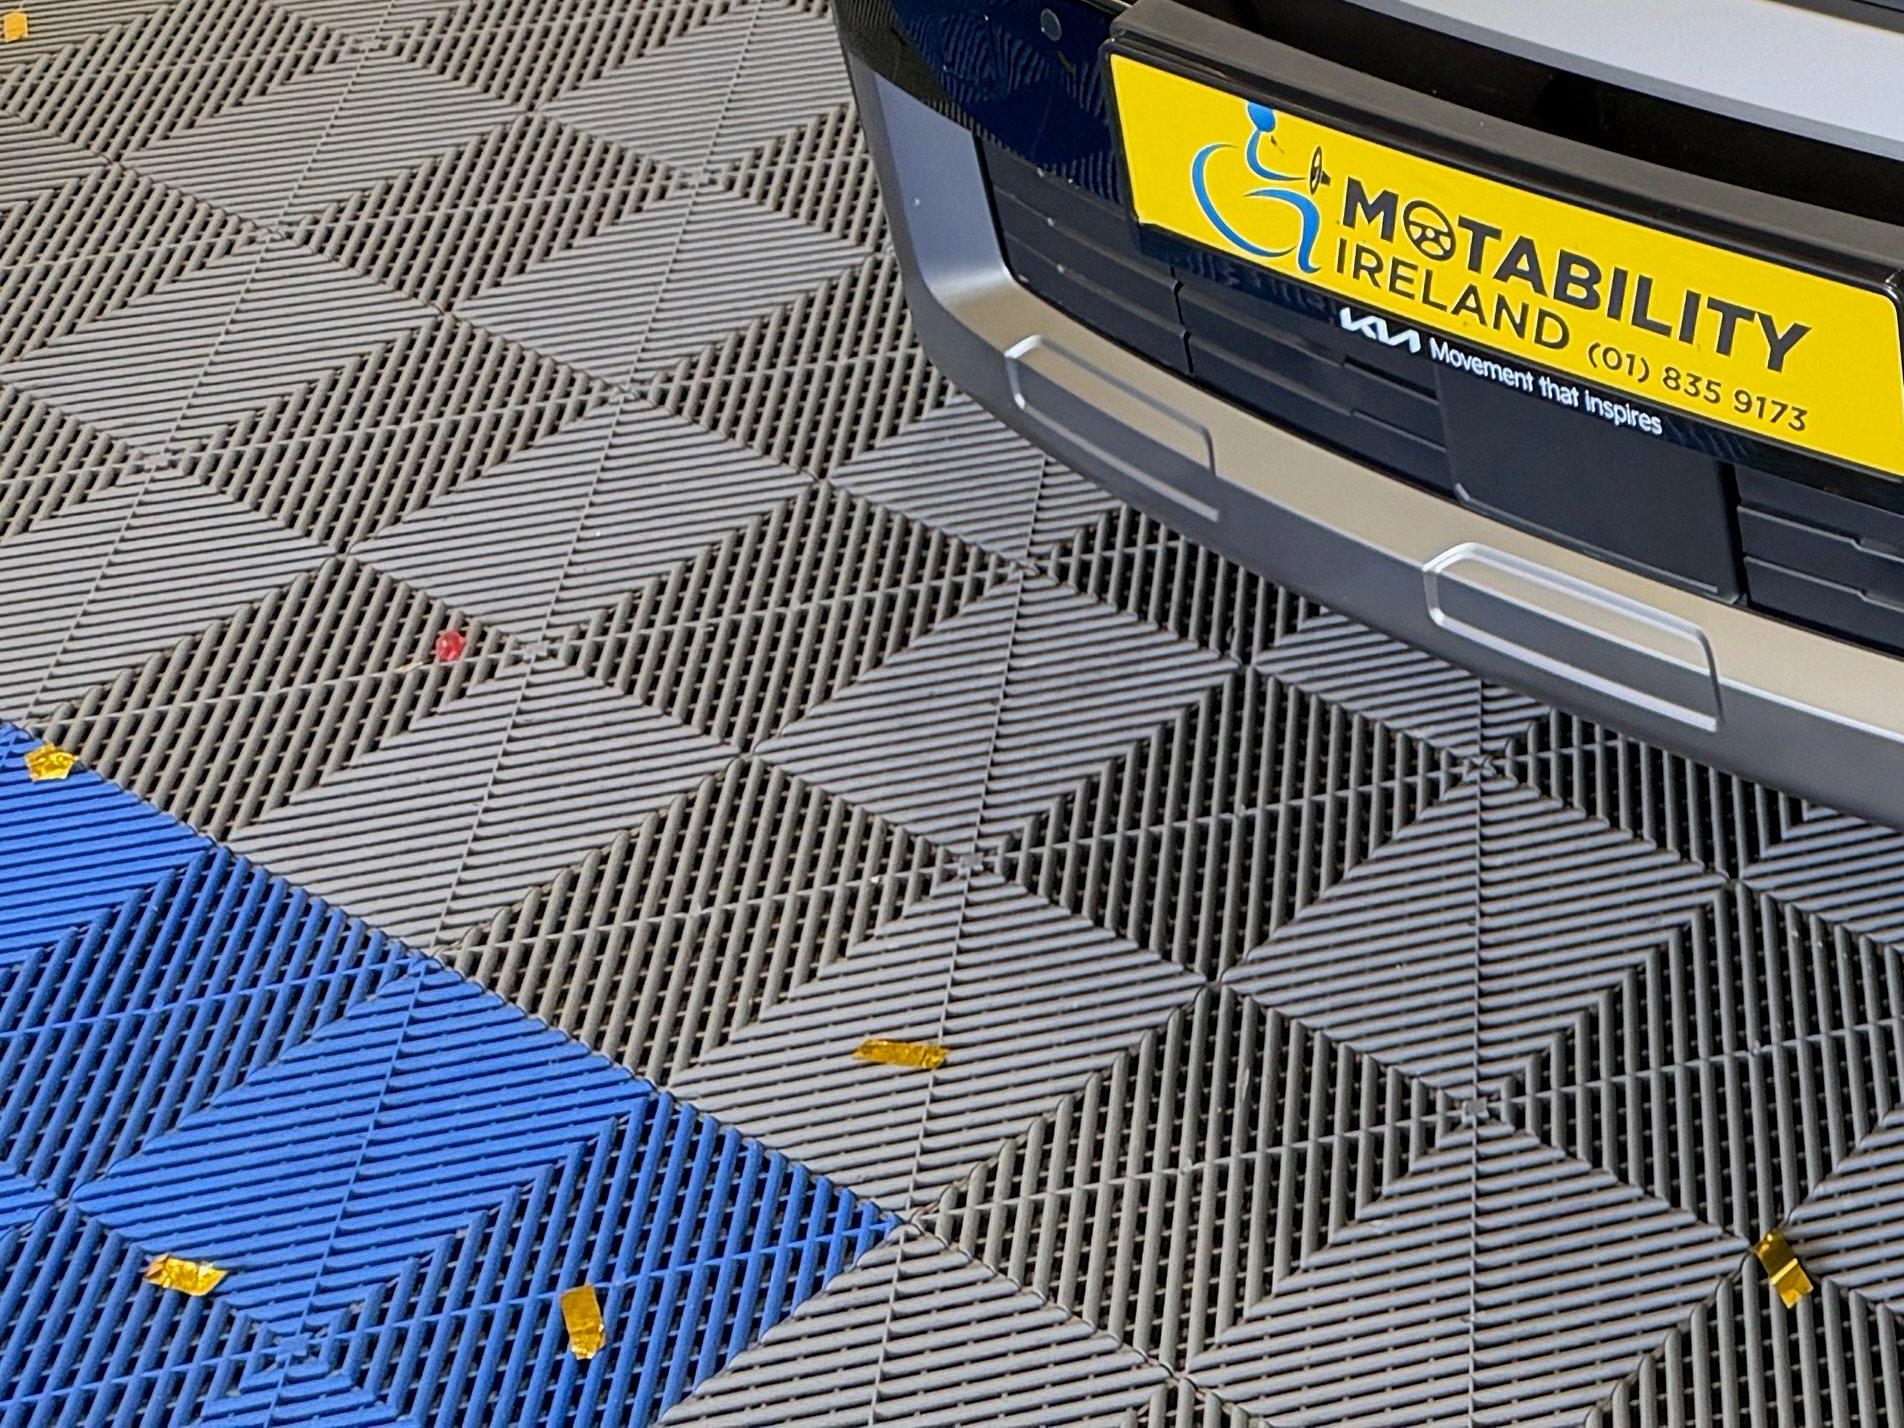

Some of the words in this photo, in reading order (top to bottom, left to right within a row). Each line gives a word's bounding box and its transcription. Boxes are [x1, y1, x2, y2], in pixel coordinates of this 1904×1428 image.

[1334, 237, 1571, 351] IRELAND
[1587, 342, 1651, 384] (01)
[1662, 365, 1723, 405] 835
[1733, 388, 1809, 432] 9173
[1339, 306, 1422, 355] KIA
[1428, 337, 1534, 393] Movement
[1538, 375, 1580, 408] that
[1584, 389, 1664, 436] inspires
[1340, 175, 1815, 374] MOTABILITY
